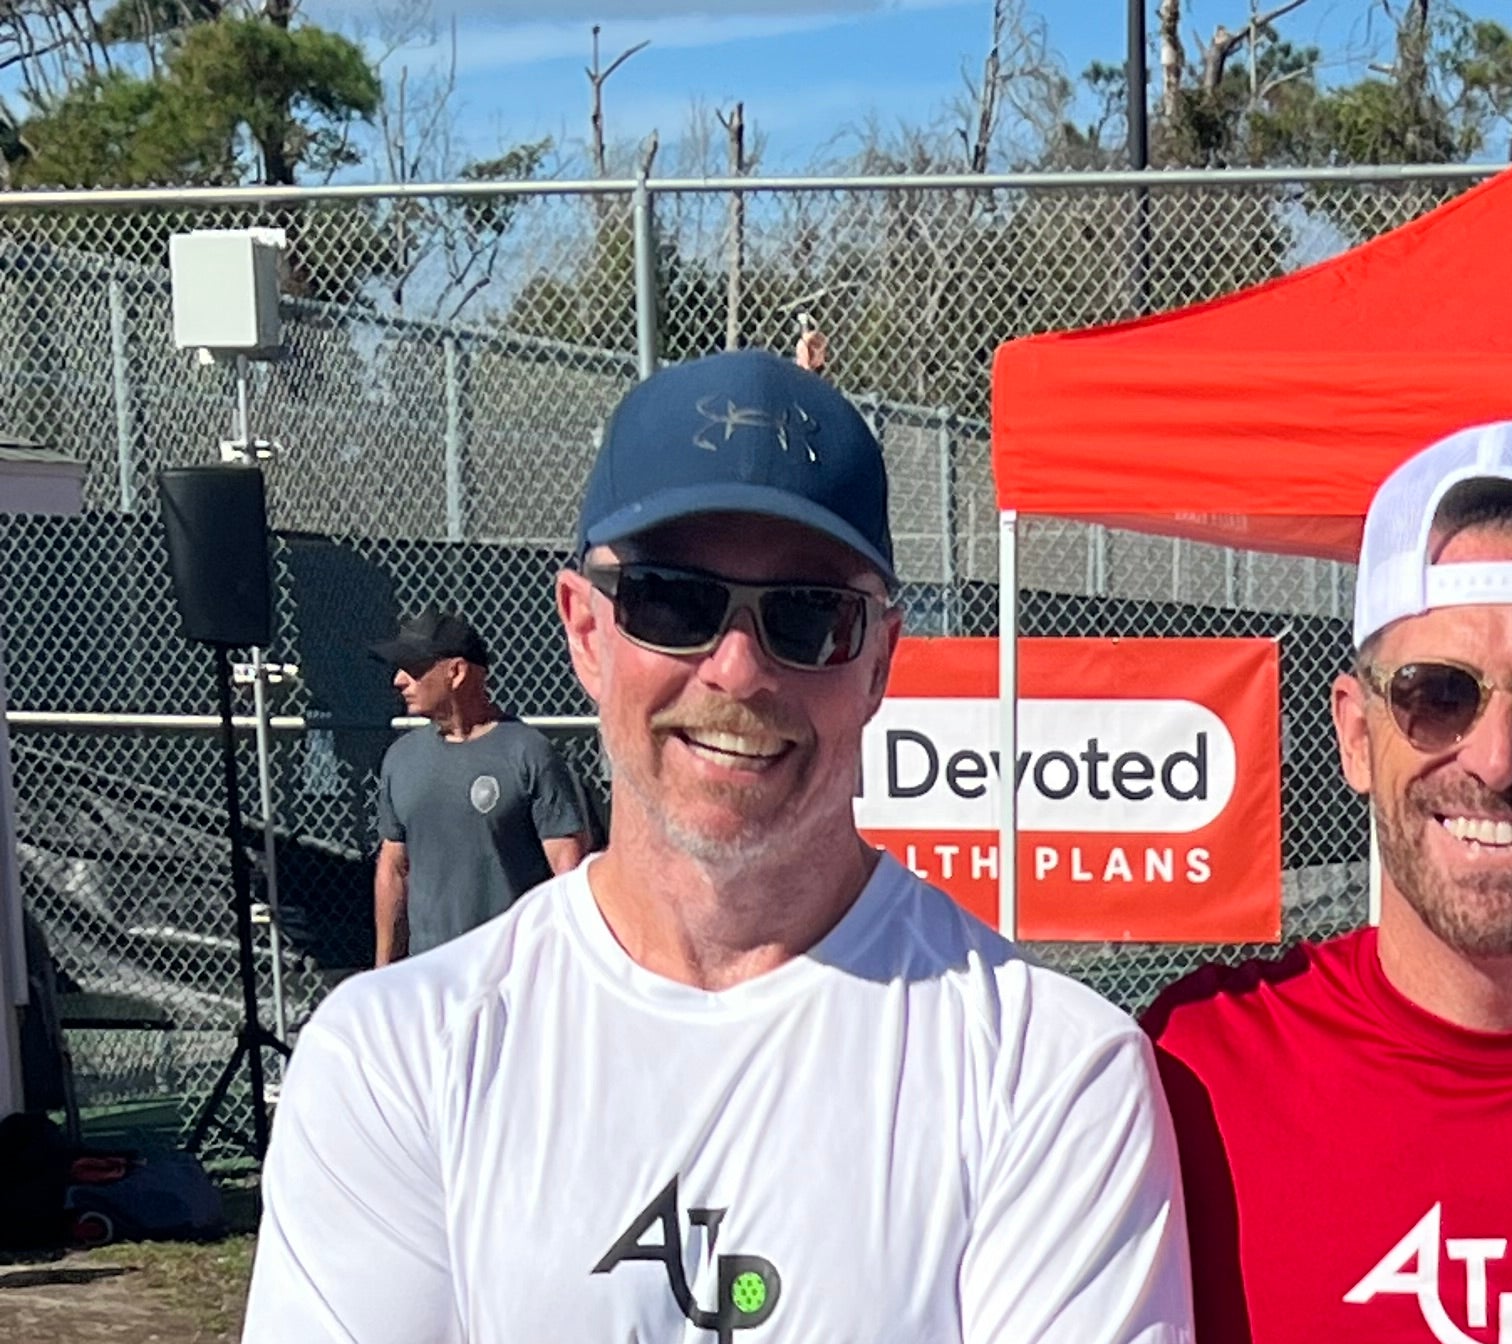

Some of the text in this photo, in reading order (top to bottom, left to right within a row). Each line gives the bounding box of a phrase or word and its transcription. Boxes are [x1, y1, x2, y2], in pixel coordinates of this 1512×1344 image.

[886, 730, 1207, 800] Devoted
[906, 845, 1212, 882] LTH PLANS
